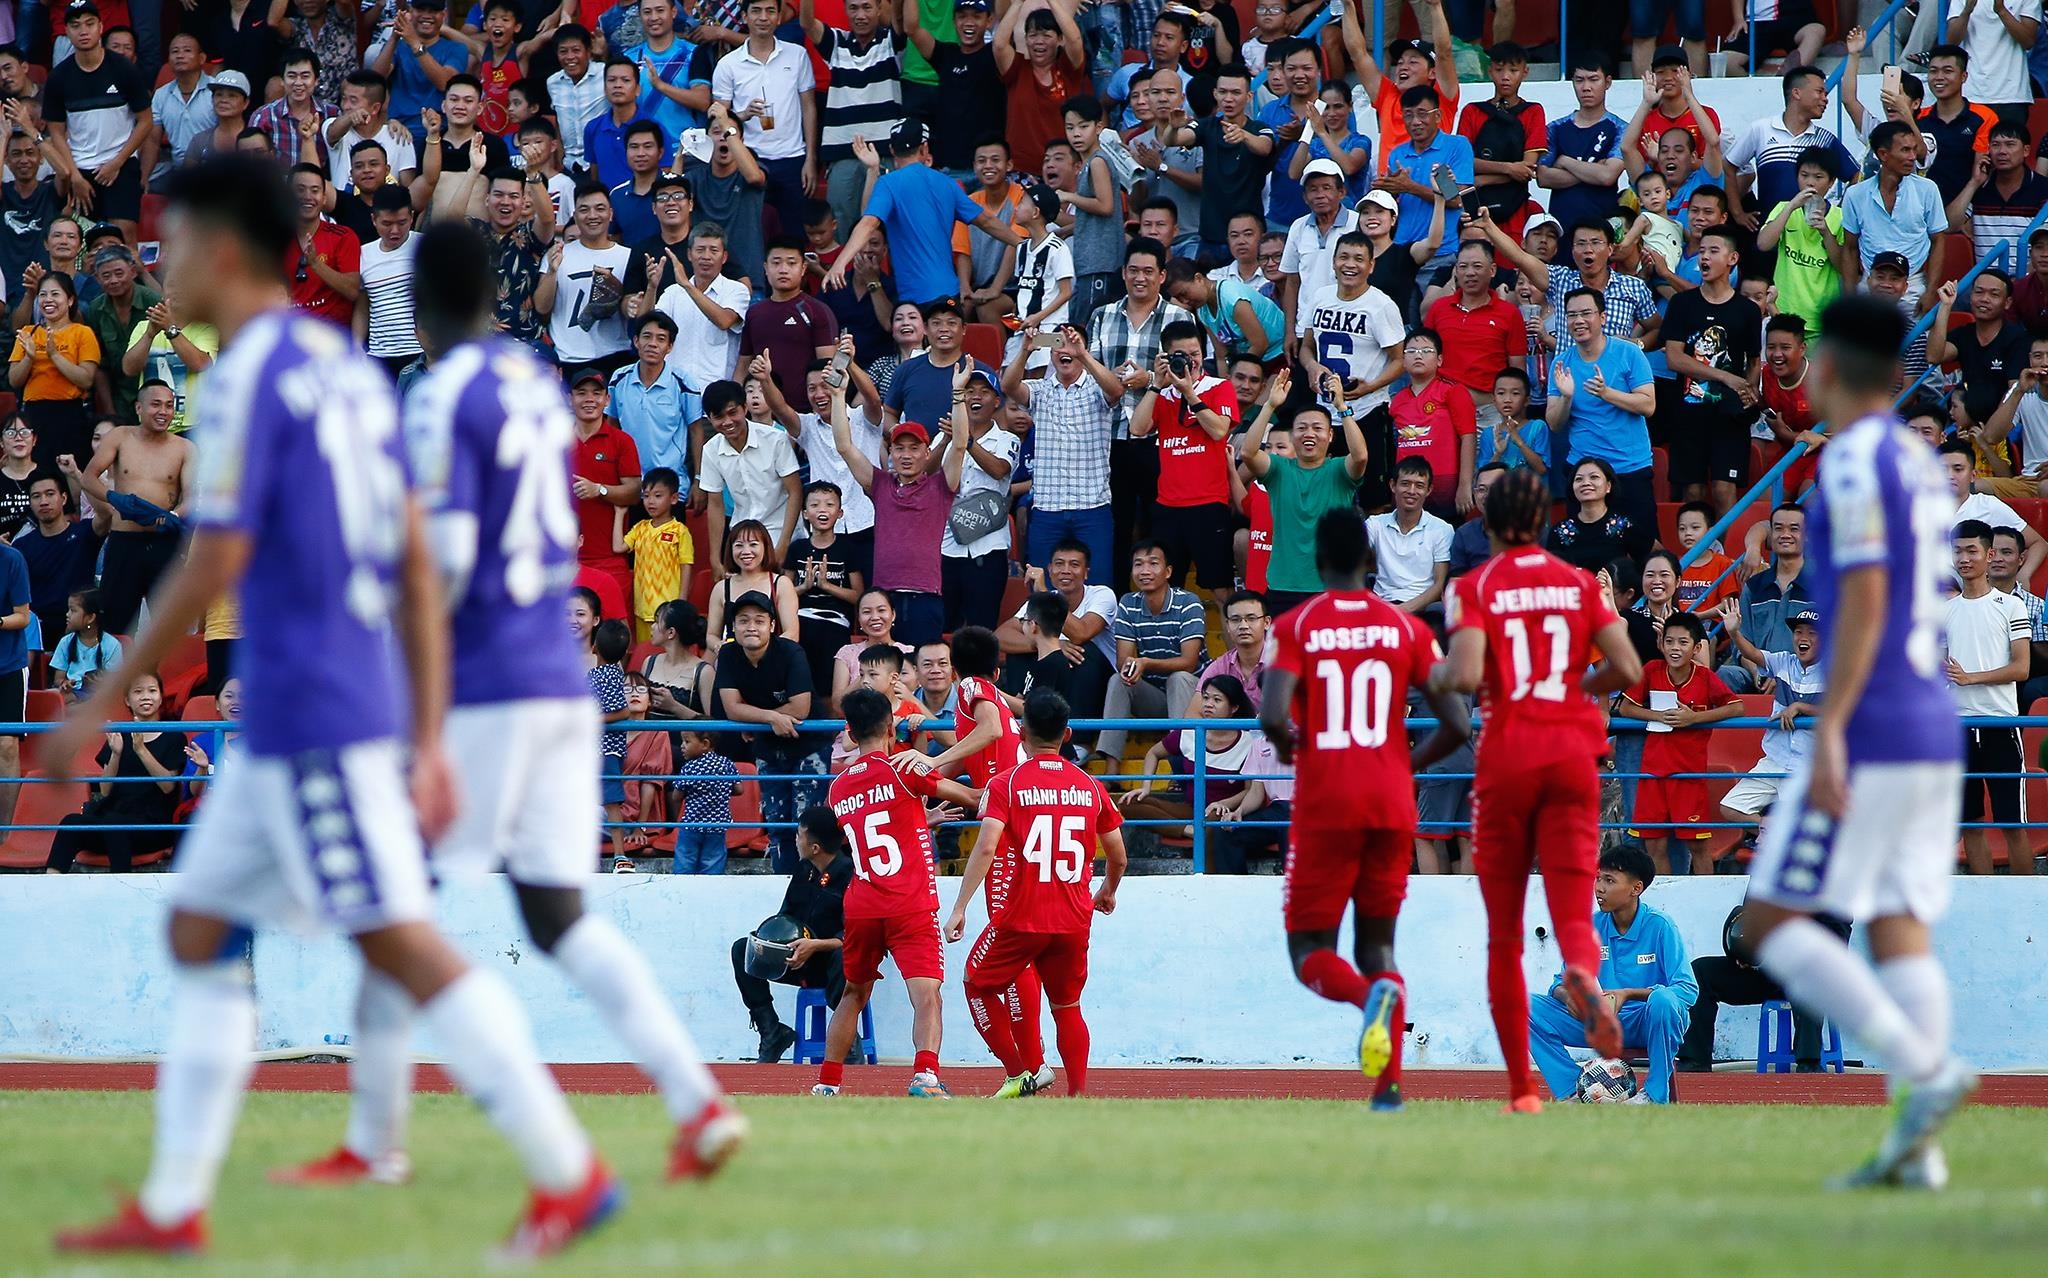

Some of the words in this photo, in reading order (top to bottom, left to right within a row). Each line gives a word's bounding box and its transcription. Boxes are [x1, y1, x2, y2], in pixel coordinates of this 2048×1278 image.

[1785, 245, 1825, 268] Rakute
[1313, 308, 1367, 335] OSAKA
[952, 514, 977, 530] FACE
[957, 508, 991, 527] NORTH
[1489, 586, 1582, 614] JERMIE
[1304, 625, 1400, 653] JOSEPH
[1504, 614, 1571, 703] 11
[1316, 658, 1393, 750] 10
[833, 793, 865, 819] NGỌC
[867, 783, 896, 805] TÂN
[1016, 785, 1059, 807] THÀNH
[842, 810, 903, 883] 15
[1022, 814, 1086, 884] 45
